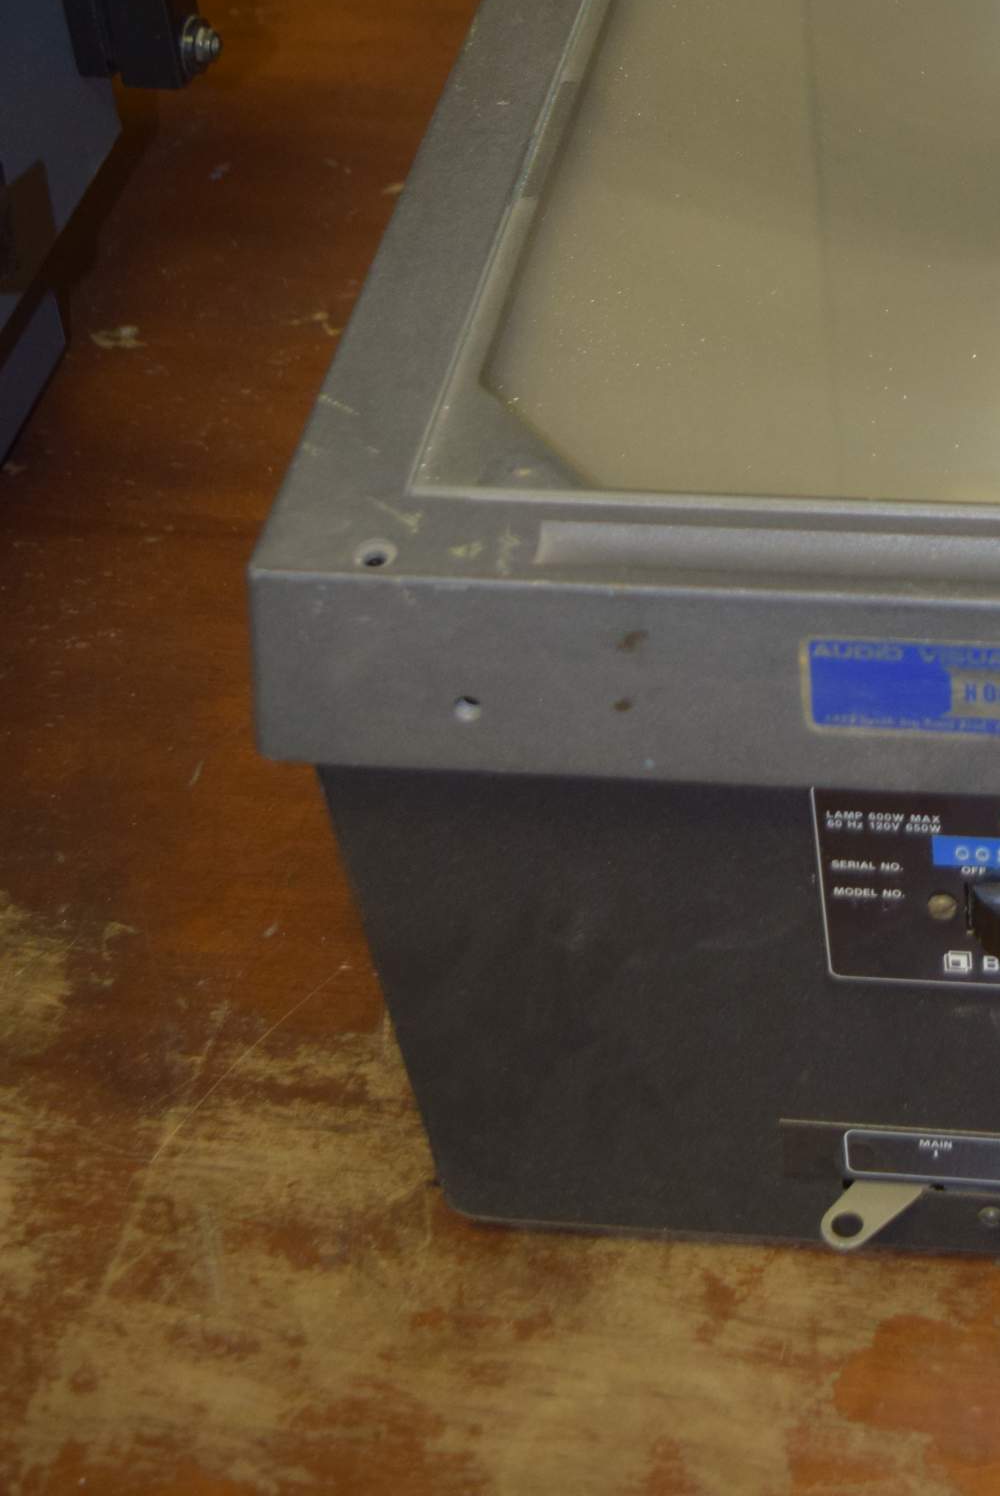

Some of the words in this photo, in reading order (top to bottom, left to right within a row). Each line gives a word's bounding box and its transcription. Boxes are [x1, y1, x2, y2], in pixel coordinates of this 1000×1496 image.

[812, 642, 904, 662] AUDIO
[826, 810, 863, 820] LAMP
[868, 812, 904, 822] 600W
[910, 814, 941, 824] MAX
[827, 819, 842, 829] 60
[847, 820, 863, 830] Hz
[870, 821, 900, 831] 120V
[905, 823, 941, 833] 650W
[831, 859, 876, 871] SERIAL
[880, 862, 904, 872] NO.
[961, 865, 986, 875] OFF
[833, 886, 878, 898] MODEL
[882, 888, 905, 899] NO.
[918, 1139, 953, 1149] MAIN
